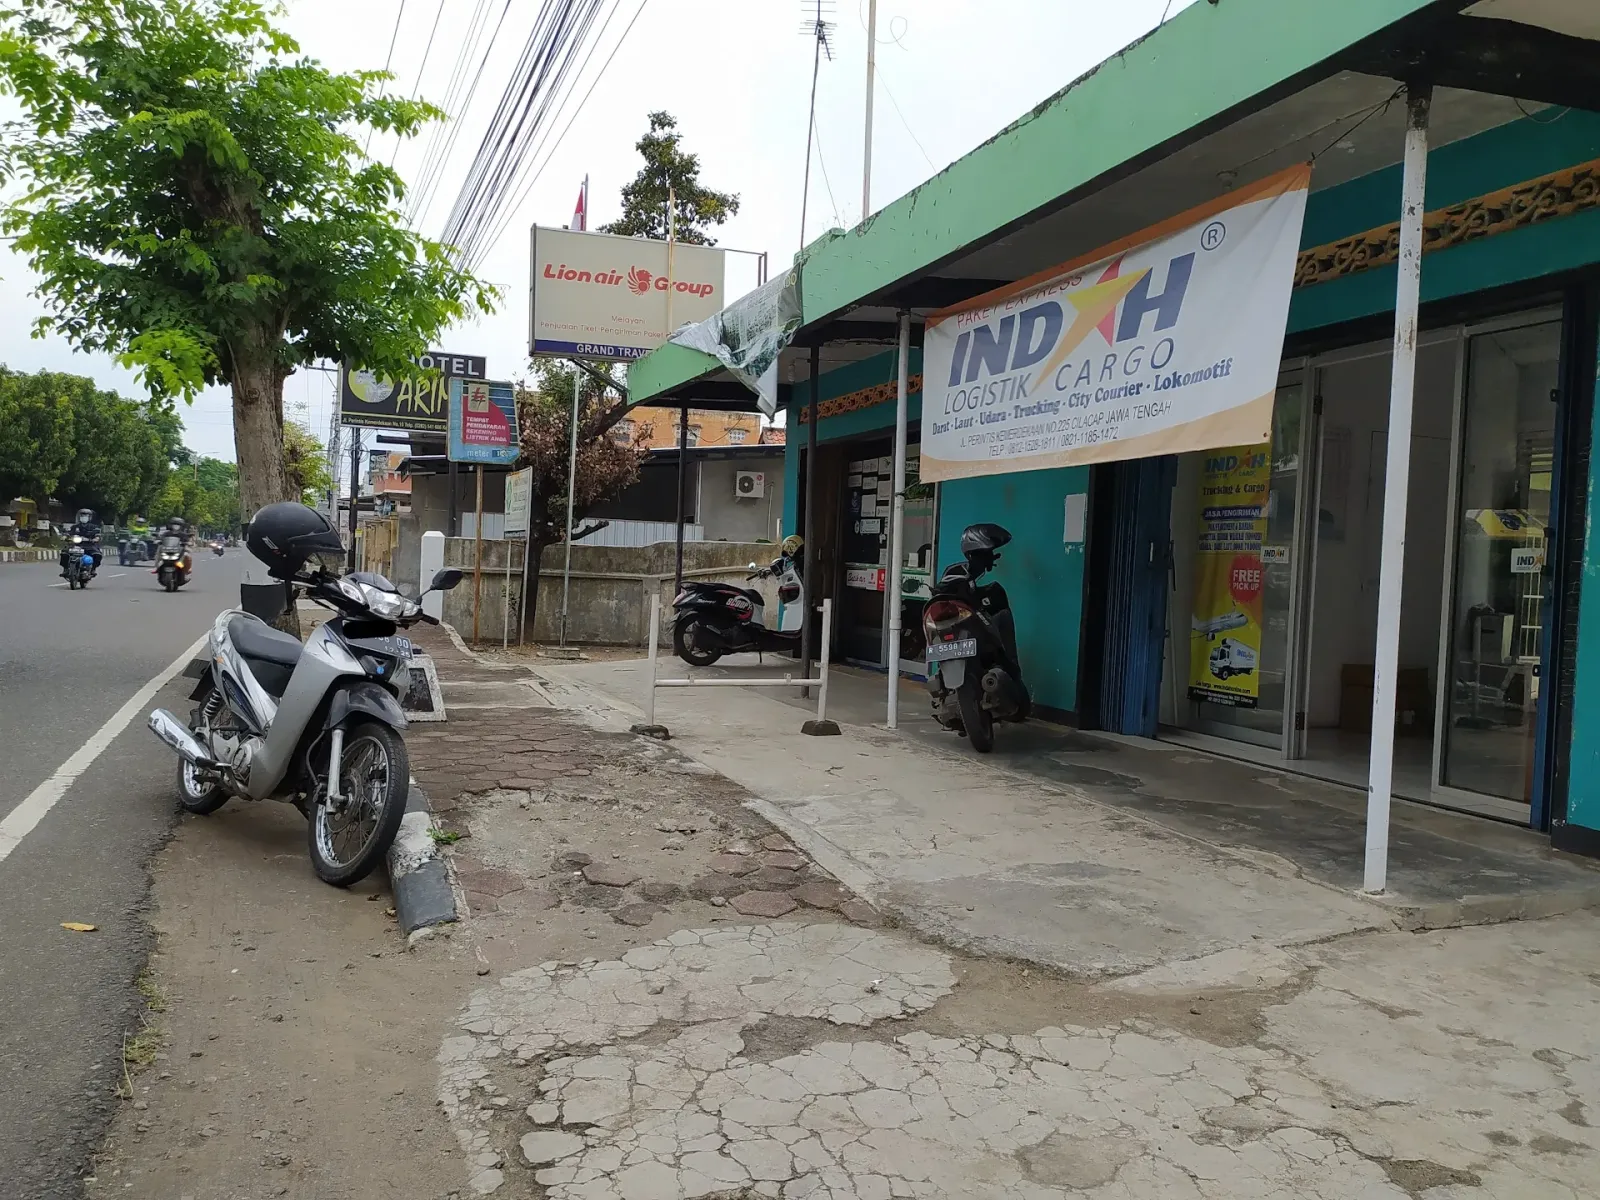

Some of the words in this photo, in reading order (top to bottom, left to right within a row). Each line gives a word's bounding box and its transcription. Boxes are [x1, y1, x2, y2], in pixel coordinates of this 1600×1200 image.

[543, 263, 592, 283] Lion
[594, 269, 624, 286] air
[654, 276, 714, 298] Group
[540, 321, 578, 331] Penjualan
[611, 315, 646, 325] Melayani
[577, 343, 614, 356] GRAND
[944, 373, 1031, 415] LOGISTIK
[1055, 337, 1174, 391] CARGO
[932, 422, 950, 436] Darat
[954, 416, 973, 430] Laut
[980, 410, 1007, 426] Udara
[1014, 399, 1060, 419] Trucking
[1068, 391, 1092, 409] City
[1094, 381, 1143, 403] Courier
[1153, 357, 1233, 391] Lokomotif
[1071, 411, 1104, 430] CILACAP
[1105, 407, 1130, 424] JAWA
[1132, 401, 1172, 420] TENGAH
[1061, 426, 1118, 447] 0821-1185-1472
[1233, 569, 1260, 583] FREE
[963, 640, 974, 649] KP
